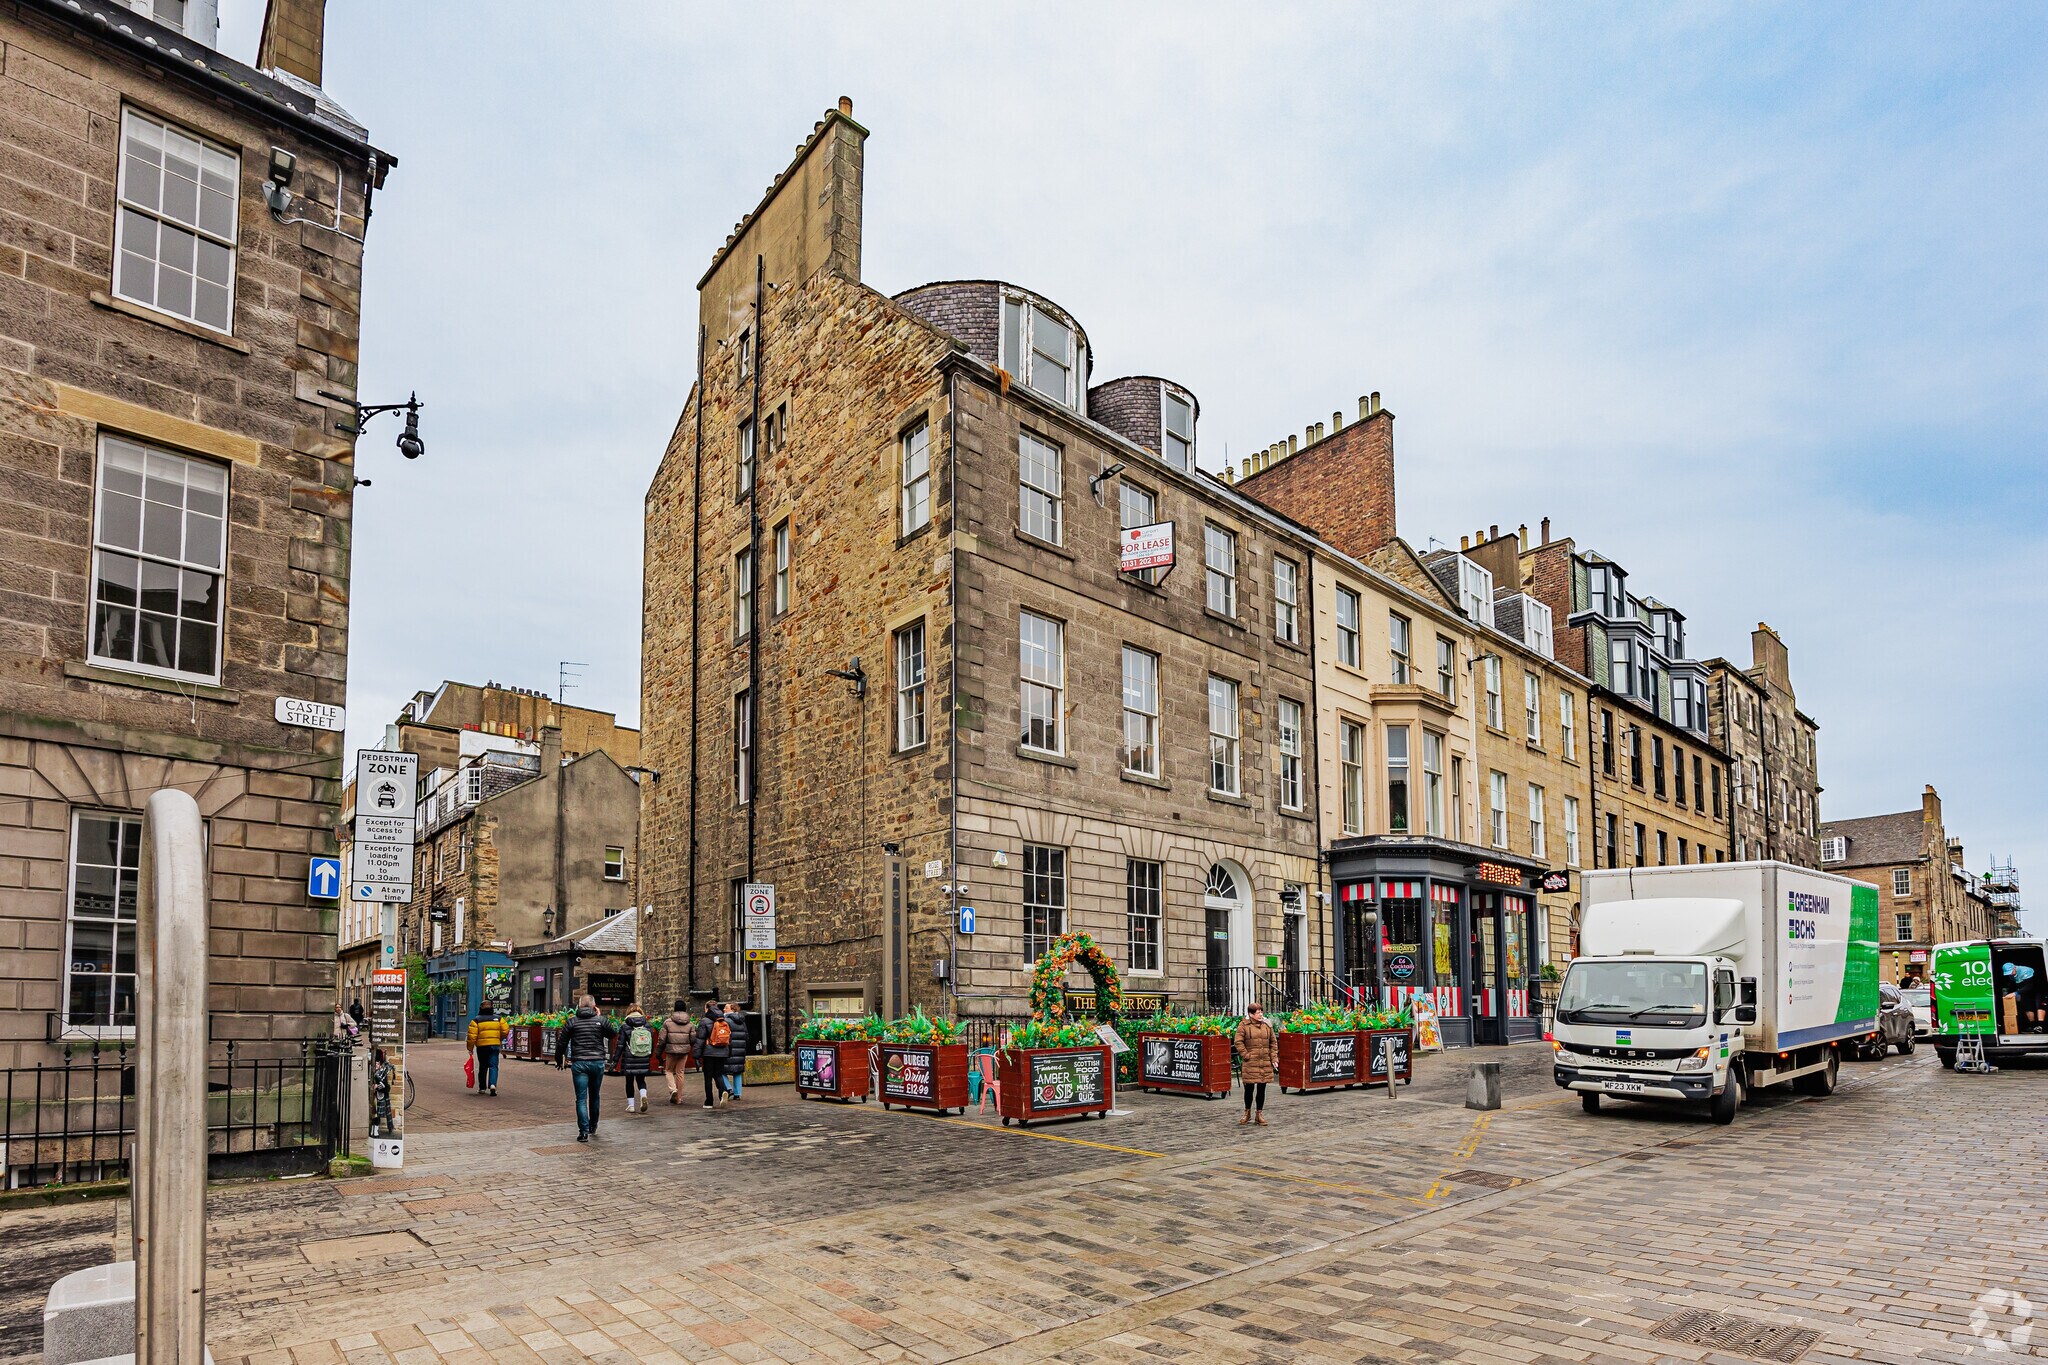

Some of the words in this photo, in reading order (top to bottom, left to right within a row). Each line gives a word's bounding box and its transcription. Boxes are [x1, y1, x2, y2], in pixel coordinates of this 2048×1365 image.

[1121, 543, 1140, 554] FOR
[1142, 538, 1170, 550] LEASE
[1121, 560, 1137, 568] 0131
[1139, 557, 1152, 565] 202
[286, 700, 336, 718] CASTLE
[287, 712, 334, 728] STREET
[362, 754, 416, 763] PEDESTRIAN
[368, 764, 407, 775] ZONE
[926, 868, 941, 877] STREET
[1479, 862, 1520, 886] FRIDAYS
[1795, 893, 1830, 914] GREENHAM
[1795, 920, 1815, 939] BCHS
[1073, 996, 1096, 1009] THE
[1137, 998, 1162, 1010] ROSE
[1147, 1042, 1160, 1055] LIVE
[1174, 1040, 1198, 1050] local
[1313, 1039, 1355, 1062] Breakfast
[1592, 1049, 1656, 1057] FUSO
[800, 1050, 815, 1059] OPEN
[903, 1054, 929, 1067] BURGER
[1174, 1050, 1198, 1060] BANDS
[802, 1060, 814, 1070] MIC
[1074, 1060, 1100, 1068] SCOTTISH
[1146, 1064, 1168, 1075] MUSIC
[1176, 1063, 1197, 1071] FRIDAY
[904, 1068, 930, 1084] Drink
[1034, 1072, 1072, 1085] AMBER
[1078, 1075, 1089, 1083] LIVE
[1033, 1084, 1073, 1103] ROSE
[1078, 1092, 1094, 1102] QUIZ
